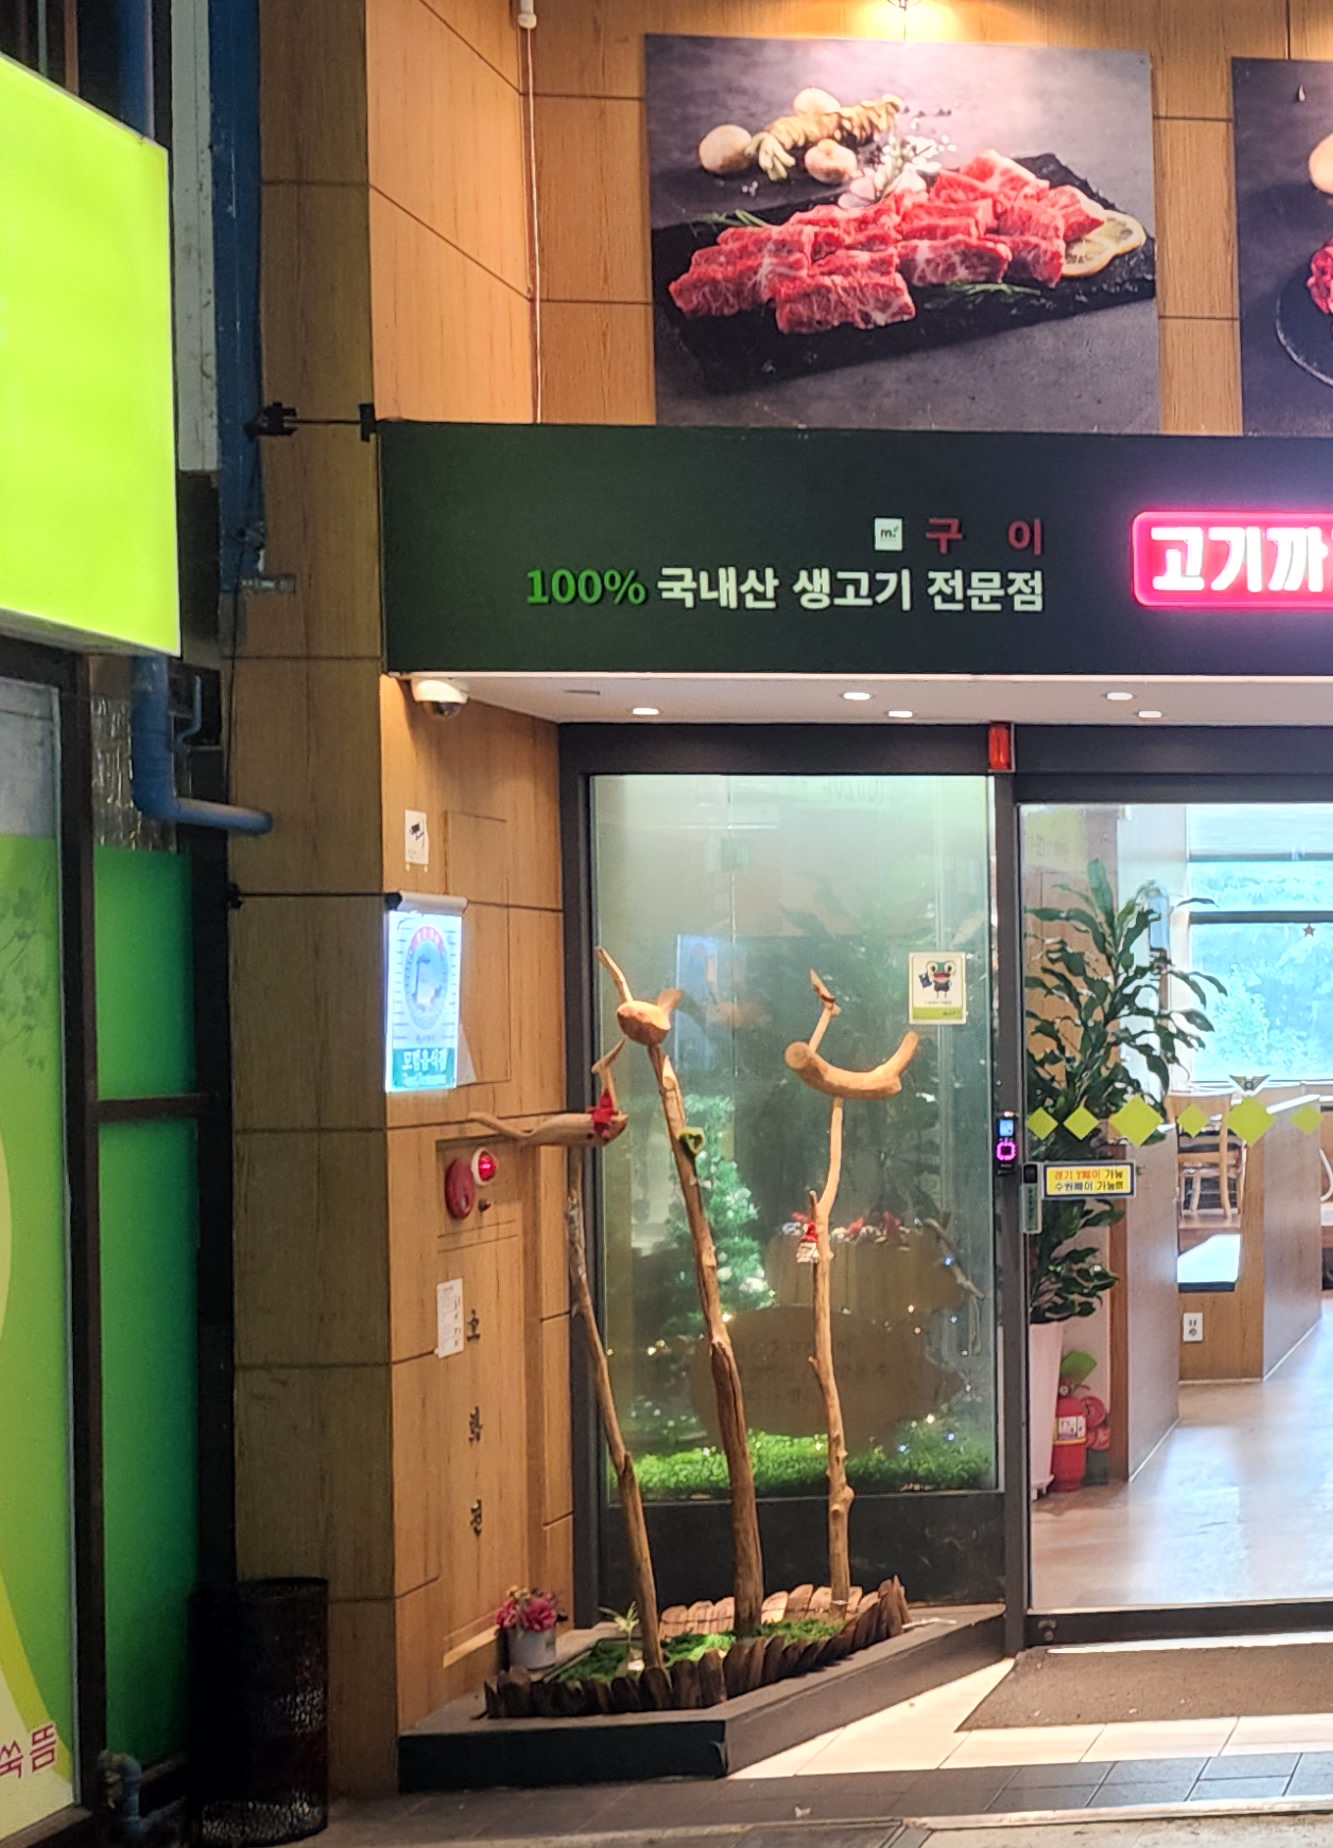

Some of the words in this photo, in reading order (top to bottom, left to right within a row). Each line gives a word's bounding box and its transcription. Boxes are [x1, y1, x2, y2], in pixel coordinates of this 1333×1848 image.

[525, 568, 646, 606] 100%
[657, 567, 778, 612] 국내산
[792, 567, 914, 612] 생고기
[927, 566, 1044, 612] 전문점
